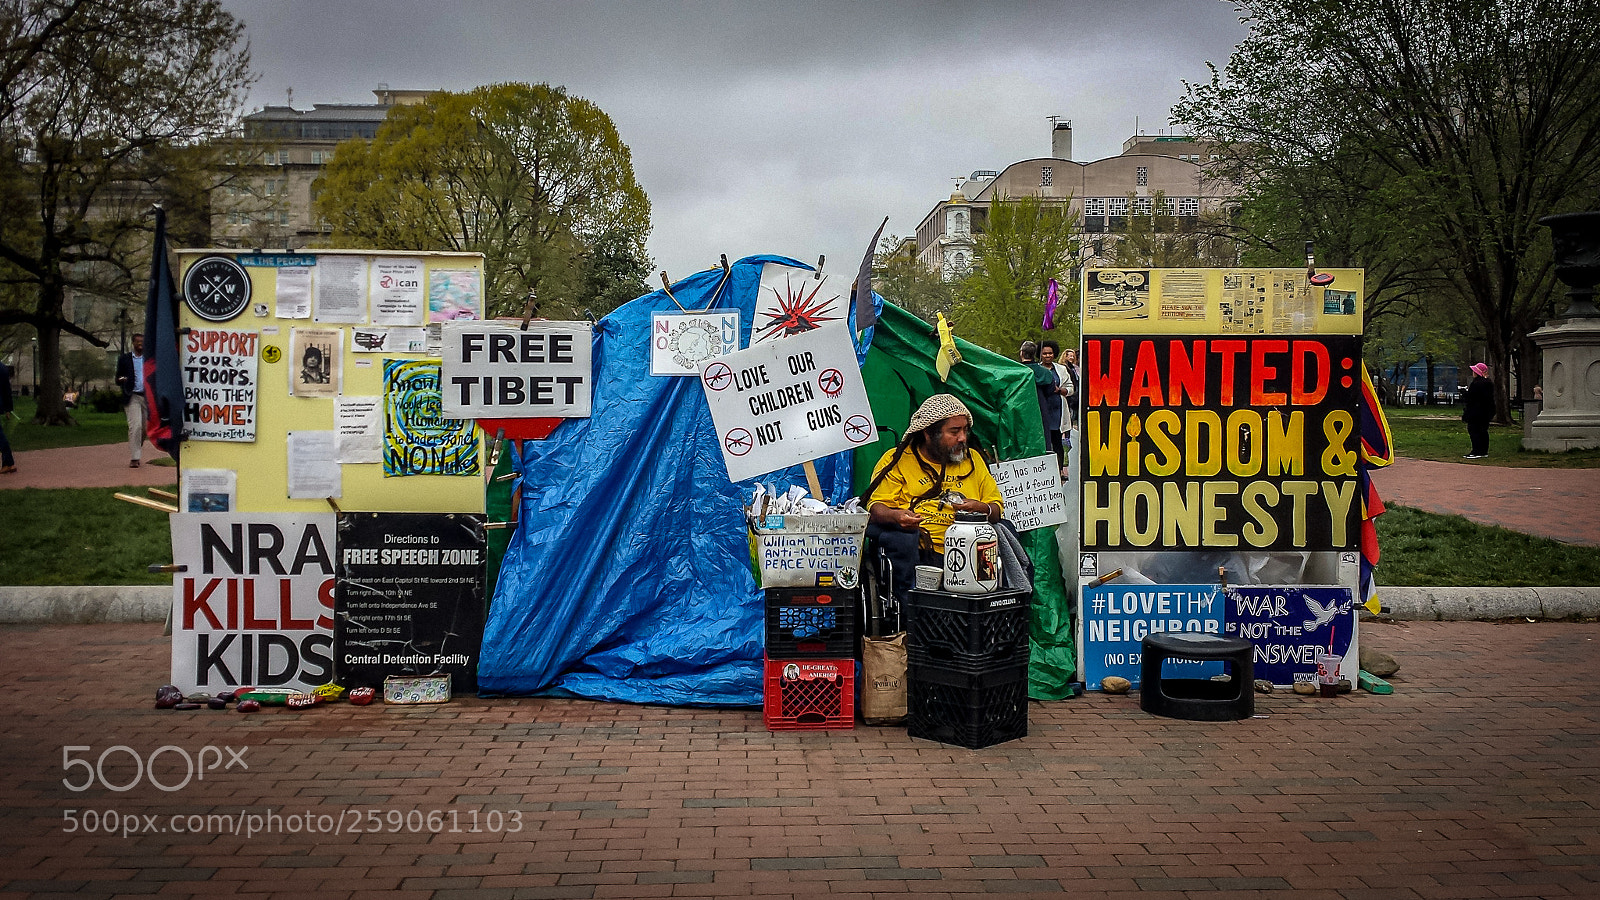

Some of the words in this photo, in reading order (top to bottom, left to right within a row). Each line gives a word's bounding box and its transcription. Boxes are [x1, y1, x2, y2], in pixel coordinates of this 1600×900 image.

[240, 257, 256, 266] WE
[258, 257, 275, 266] THE
[395, 279, 418, 288] ican
[187, 330, 258, 357] SUPPORT
[462, 334, 574, 363] FREE
[199, 356, 233, 367] OUR
[733, 364, 770, 392] LOVE
[787, 351, 816, 376] OUR
[1087, 340, 1353, 406] WANTED:
[185, 387, 219, 401] BRING
[221, 388, 254, 402] THEM
[451, 377, 583, 406] TIBET
[748, 380, 815, 416] CHILDREN
[183, 403, 254, 425] HOME!
[425, 396, 442, 412] lea
[755, 421, 783, 446] NOT
[806, 404, 842, 431] GUNS
[1321, 409, 1358, 477] &
[1012, 464, 1029, 478] has
[1033, 461, 1047, 473] not
[1004, 483, 1023, 496] tried
[1033, 476, 1055, 489] found
[1033, 493, 1047, 503] has
[1048, 491, 1063, 501] been
[1010, 507, 1037, 520] difficult
[1046, 503, 1061, 513] left
[1083, 480, 1357, 547] HONESTY
[200, 523, 335, 575] NRA
[384, 534, 429, 544] Directions
[430, 534, 440, 544] to
[763, 536, 806, 547] William
[809, 535, 854, 545] Thomas
[945, 537, 966, 547] GIVE
[343, 548, 378, 565] FREE
[380, 549, 439, 565] SPEECH
[441, 549, 479, 565] ZONE
[765, 558, 804, 570] PEACE
[182, 578, 335, 630] KILLS
[1091, 592, 1217, 615] #LOVETHY
[1237, 594, 1289, 617] WAR
[1225, 622, 1236, 632] IS
[1239, 622, 1272, 639] NOT
[1274, 626, 1302, 636] THE
[196, 633, 334, 686] KIDS
[344, 654, 381, 664] Central
[383, 654, 431, 664] Detention
[433, 654, 470, 666] Facility
[1104, 653, 1125, 668] (NO
[1252, 644, 1326, 664] NSWER
